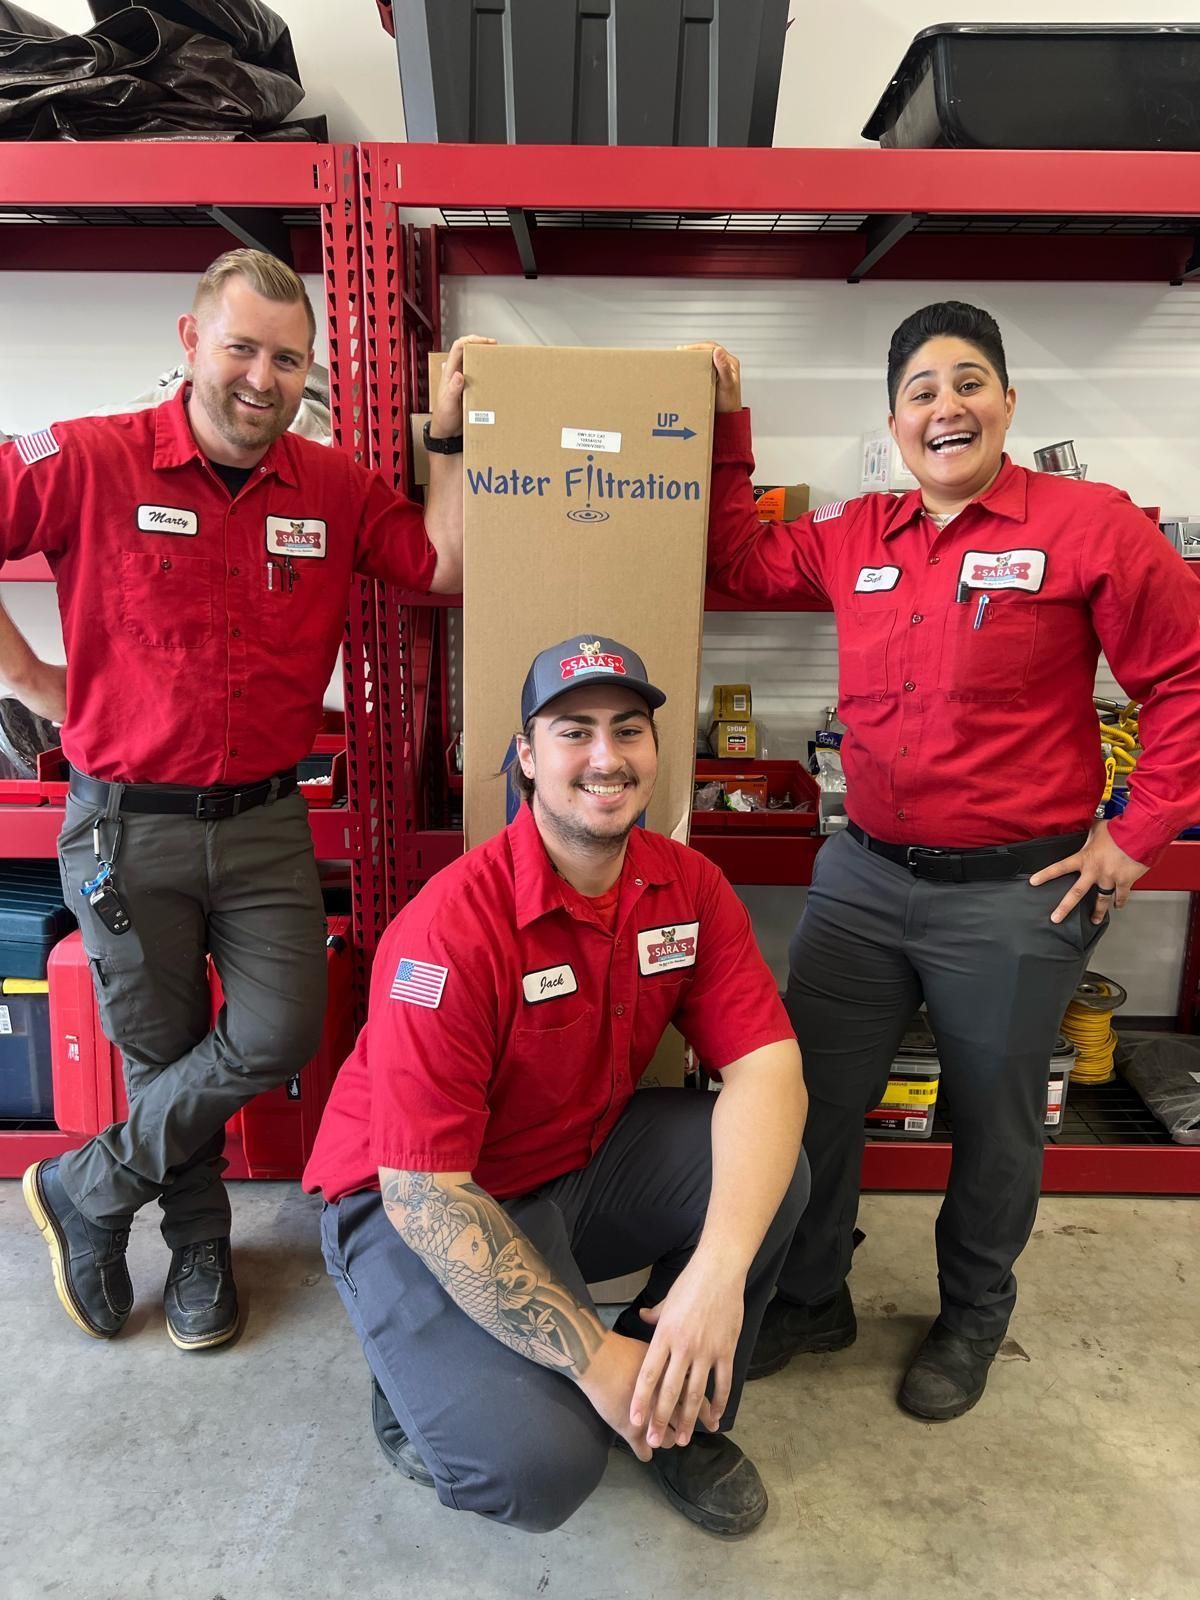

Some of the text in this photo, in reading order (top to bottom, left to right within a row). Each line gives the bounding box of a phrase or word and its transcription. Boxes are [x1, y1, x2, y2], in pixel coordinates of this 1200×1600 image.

[657, 413, 679, 427] UP
[467, 455, 700, 500] Water Filtration
[149, 511, 188, 528] Marty
[282, 534, 315, 544] SARA'S
[981, 566, 1019, 577] SARA'S
[570, 656, 614, 670] SARA'S
[655, 942, 687, 957] SARA'S
[540, 973, 564, 994] Jack
